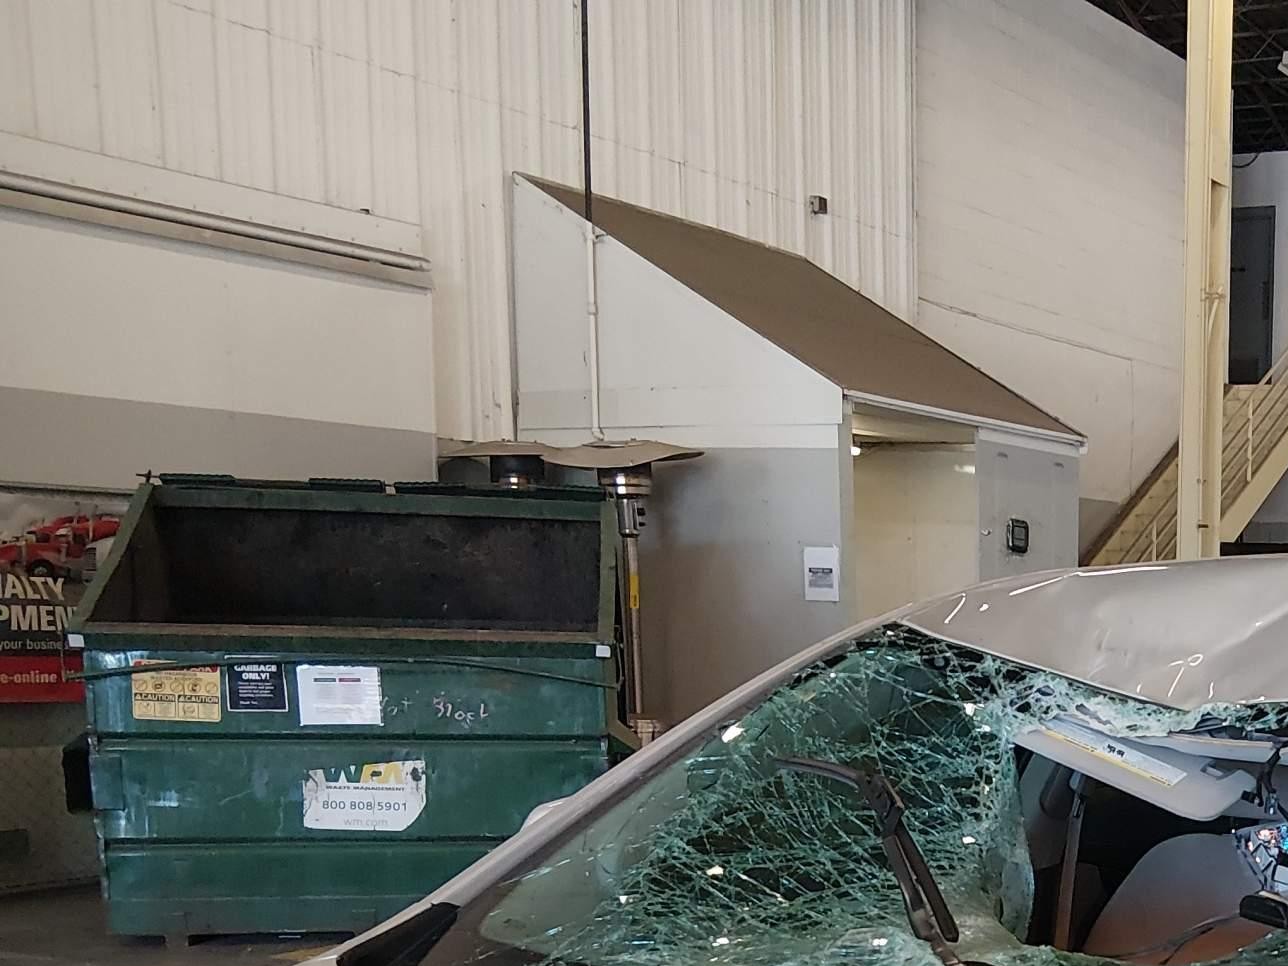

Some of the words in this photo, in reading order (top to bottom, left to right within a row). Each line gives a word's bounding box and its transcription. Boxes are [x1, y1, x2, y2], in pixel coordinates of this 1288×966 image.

[322, 799, 346, 811] 800
[349, 800, 373, 812] 808
[377, 801, 407, 812] 5901
